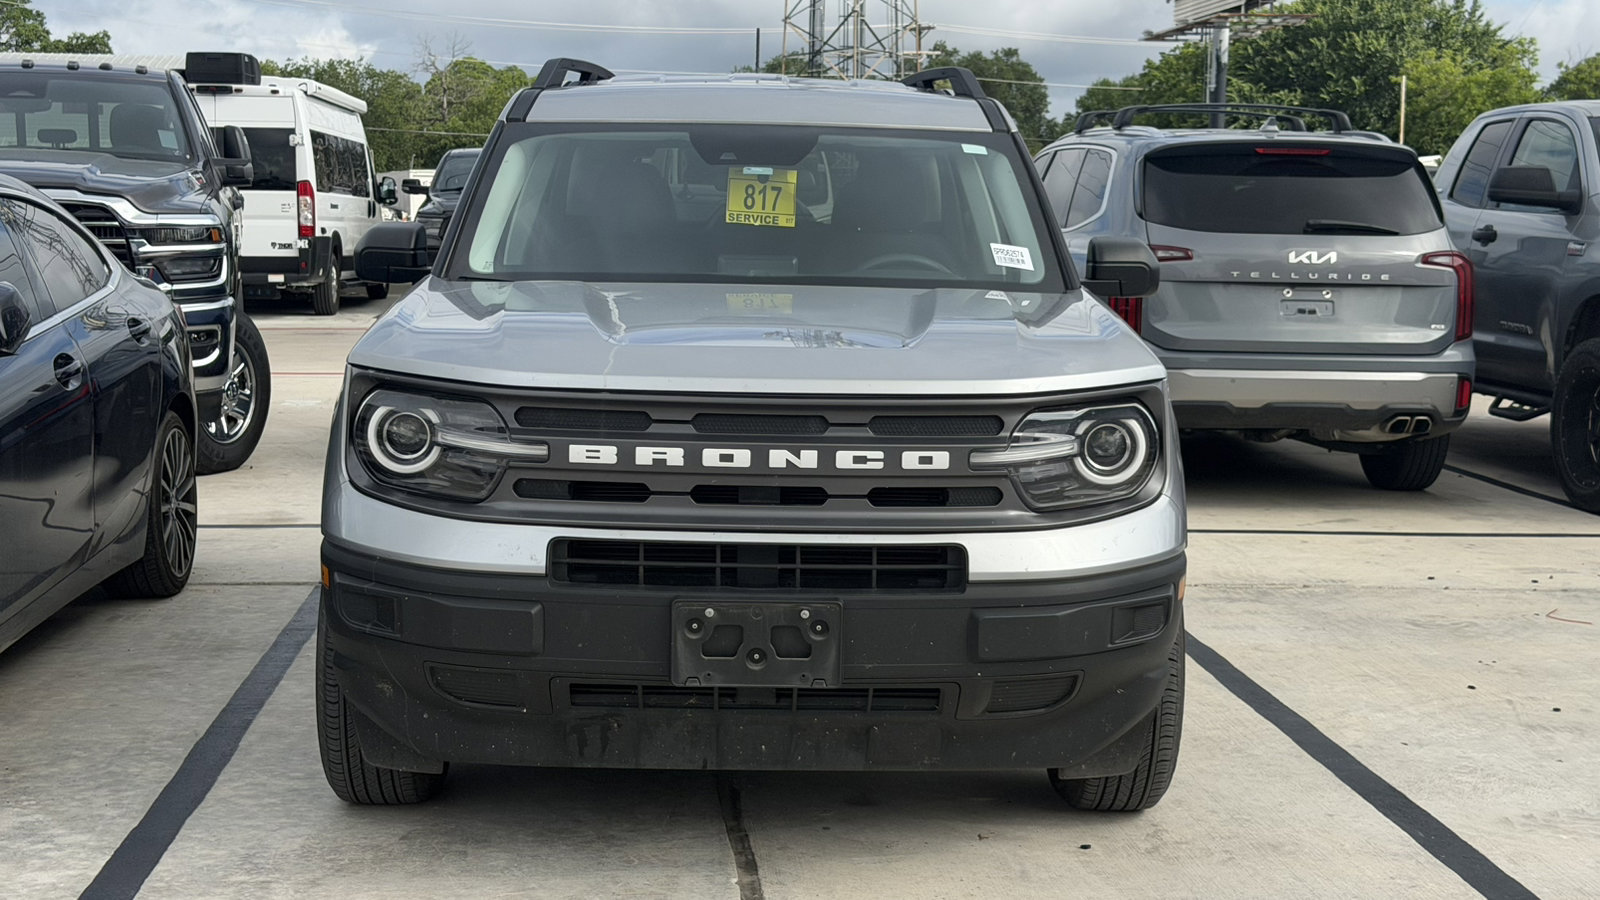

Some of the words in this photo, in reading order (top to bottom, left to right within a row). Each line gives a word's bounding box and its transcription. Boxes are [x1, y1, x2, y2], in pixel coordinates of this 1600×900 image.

[743, 184, 782, 211] 817
[728, 213, 780, 225] SERVICE
[1288, 250, 1338, 264] KIA
[1230, 271, 1390, 281] TELLURIDE
[569, 444, 949, 469] BRONCO
